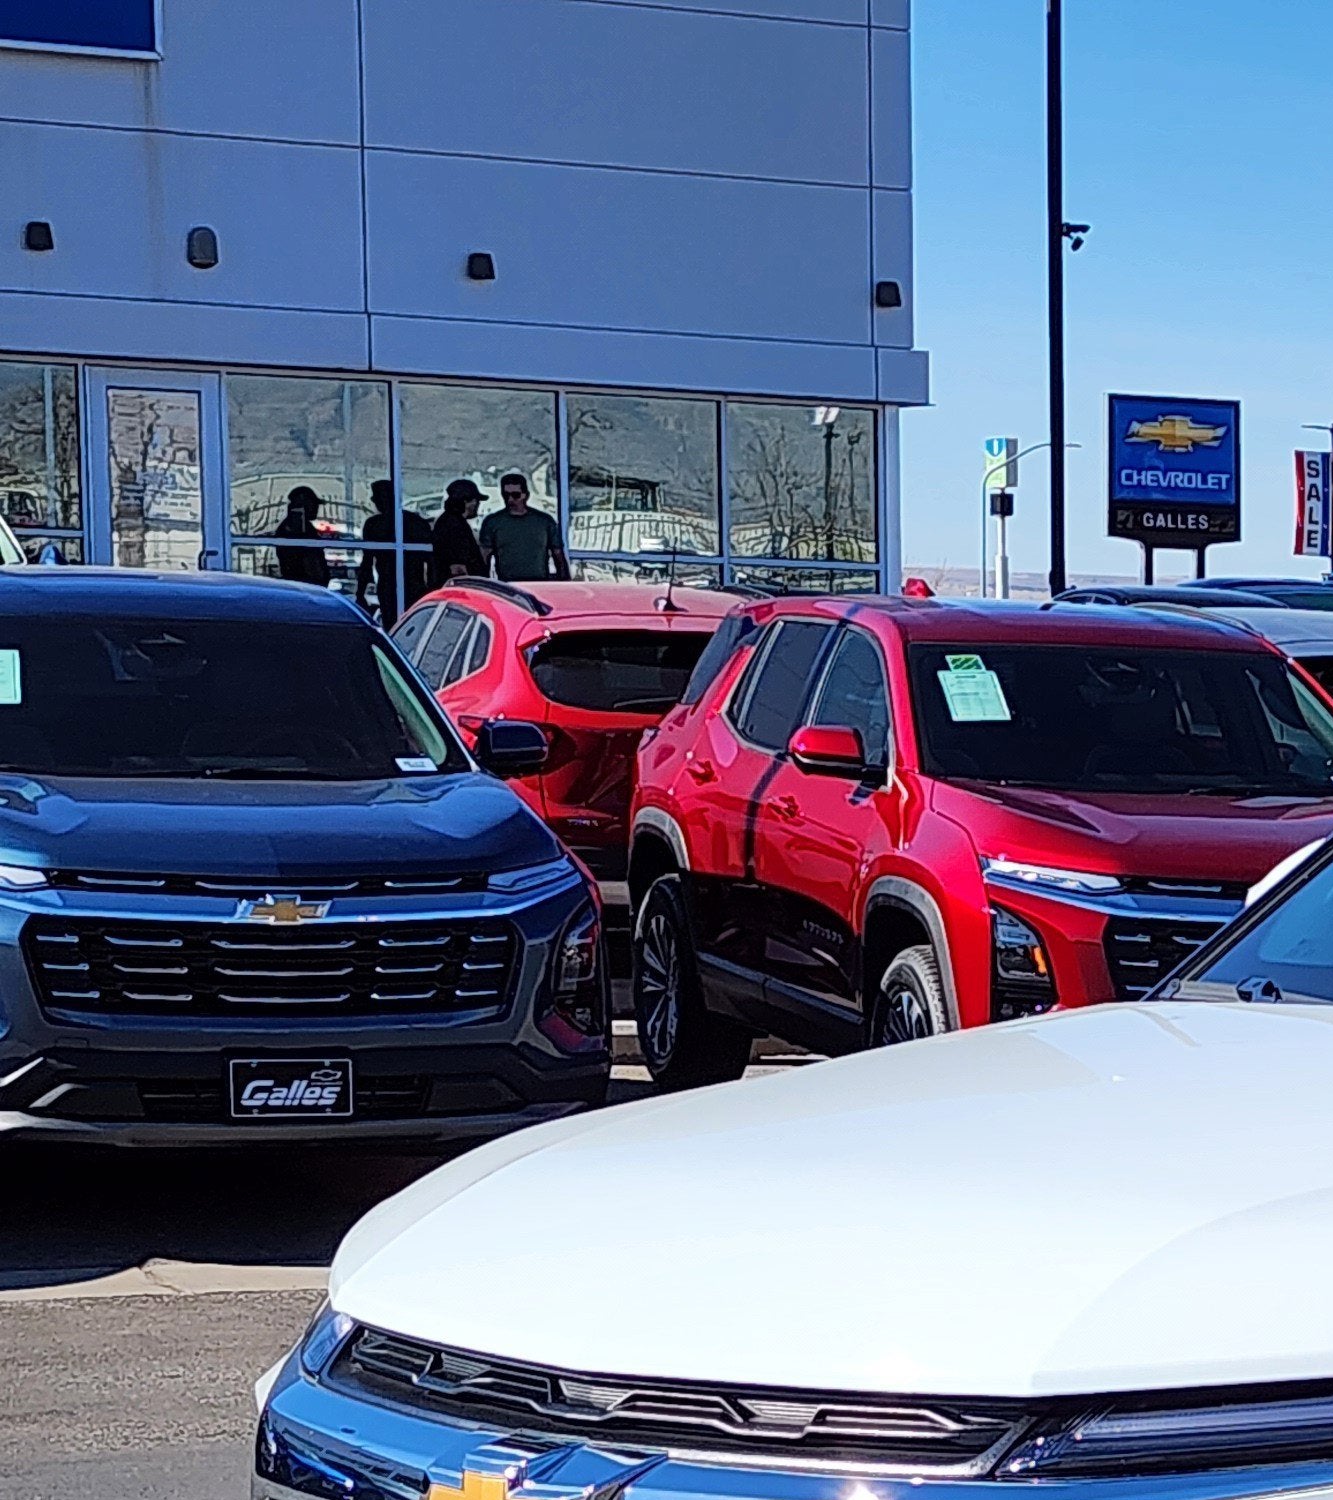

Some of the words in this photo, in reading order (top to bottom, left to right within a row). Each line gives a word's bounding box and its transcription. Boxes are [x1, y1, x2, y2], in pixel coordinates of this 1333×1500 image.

[1120, 468, 1231, 490] CHEVROLET
[1306, 460, 1321, 548] SALE
[1143, 512, 1209, 530] GALLES
[240, 1079, 342, 1106] Galles
